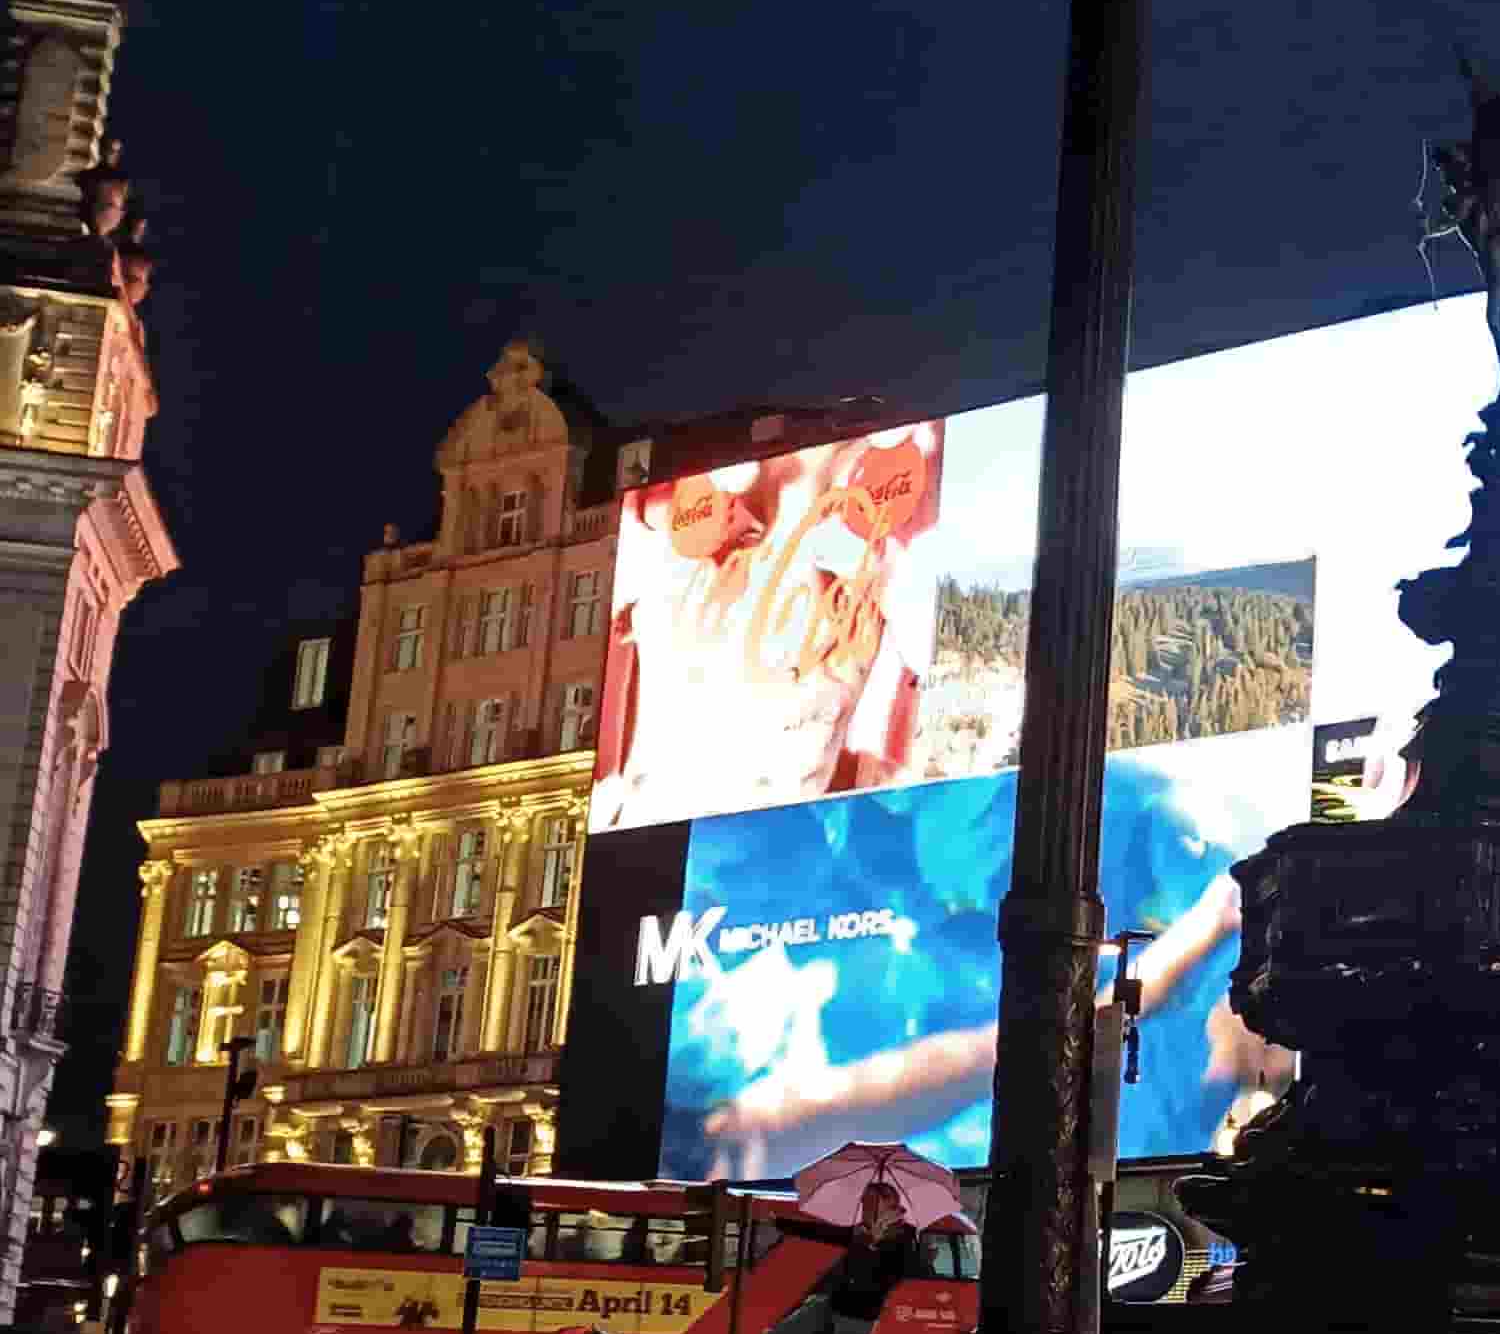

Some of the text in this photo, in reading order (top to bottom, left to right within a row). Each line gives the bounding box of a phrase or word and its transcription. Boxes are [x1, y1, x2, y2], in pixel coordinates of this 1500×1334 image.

[633, 905, 897, 986] MK MICHAEL KORS
[577, 1288, 652, 1320] April
[661, 1291, 692, 1316] 14
